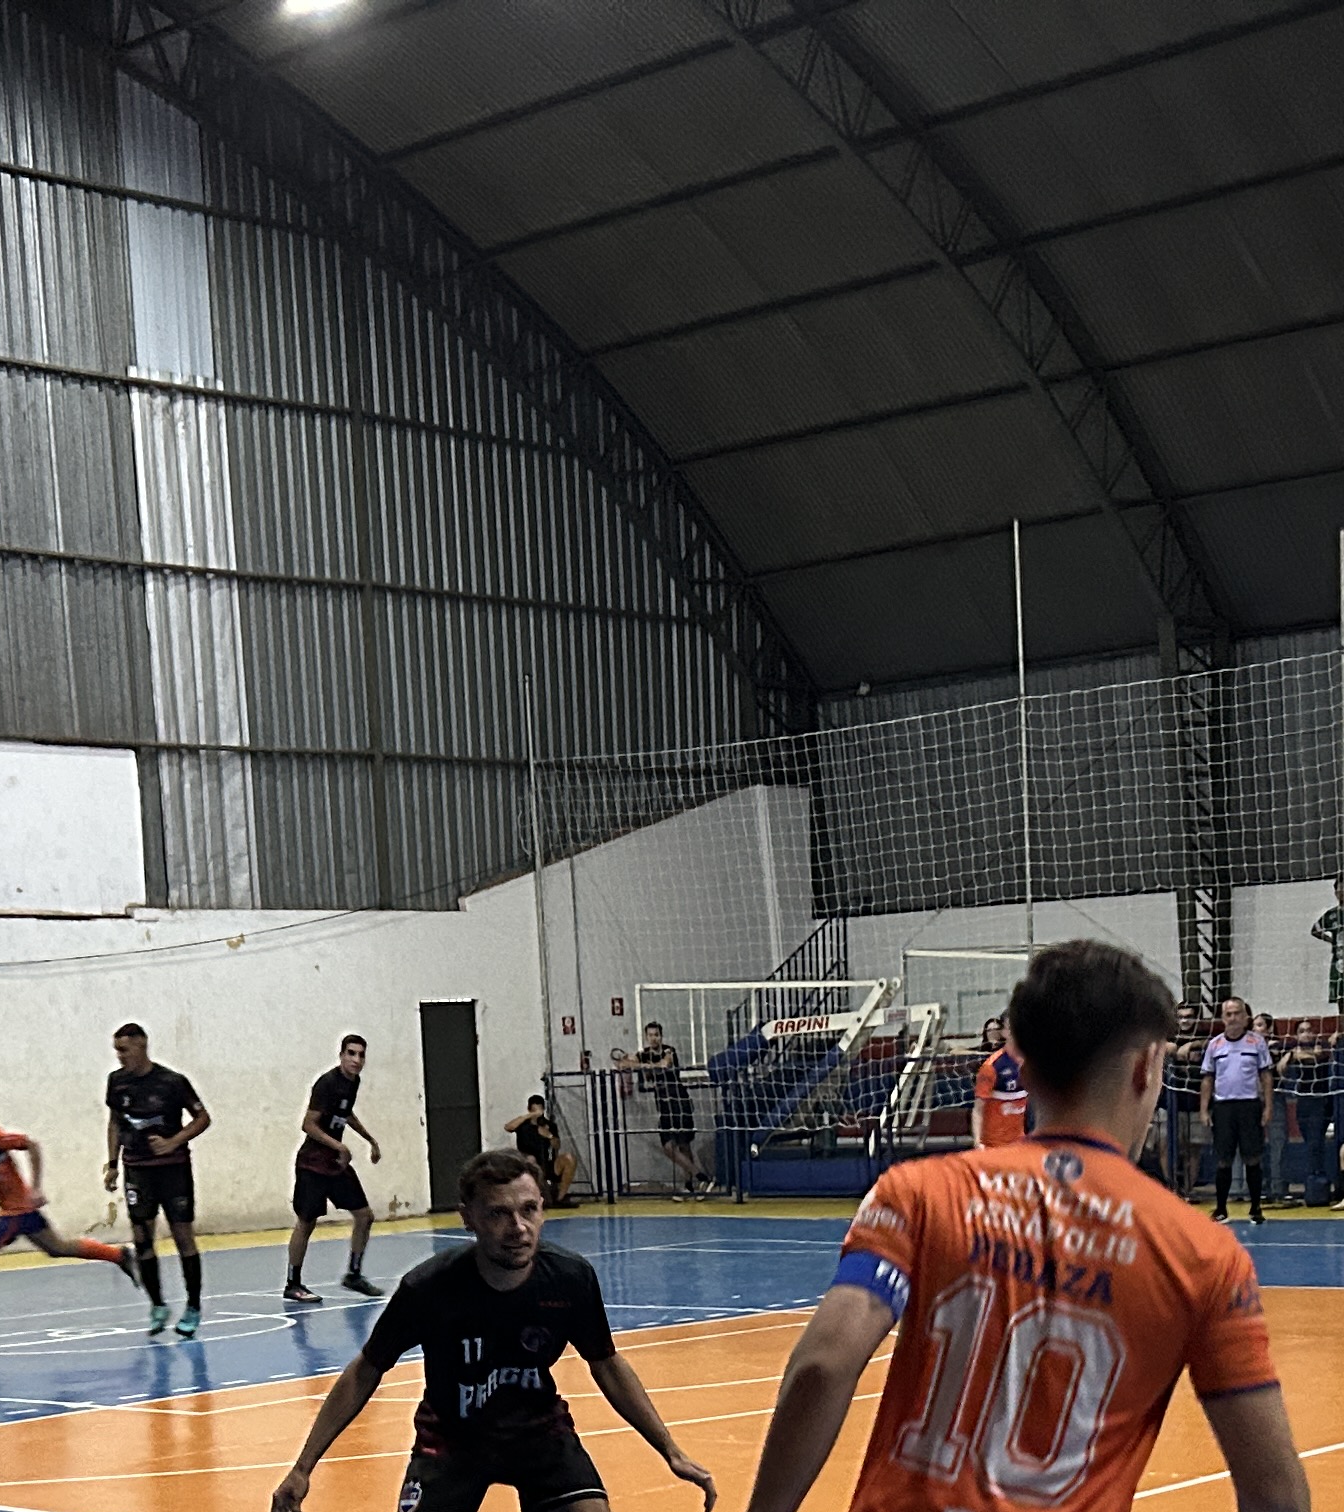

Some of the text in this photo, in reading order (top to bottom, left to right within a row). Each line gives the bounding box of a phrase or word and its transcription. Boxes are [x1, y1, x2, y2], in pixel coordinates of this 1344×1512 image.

[773, 1015, 830, 1034] RAPINI
[460, 1337, 483, 1365] 11
[457, 1366, 543, 1419] PRAGA
[891, 1272, 1127, 1507] 10
